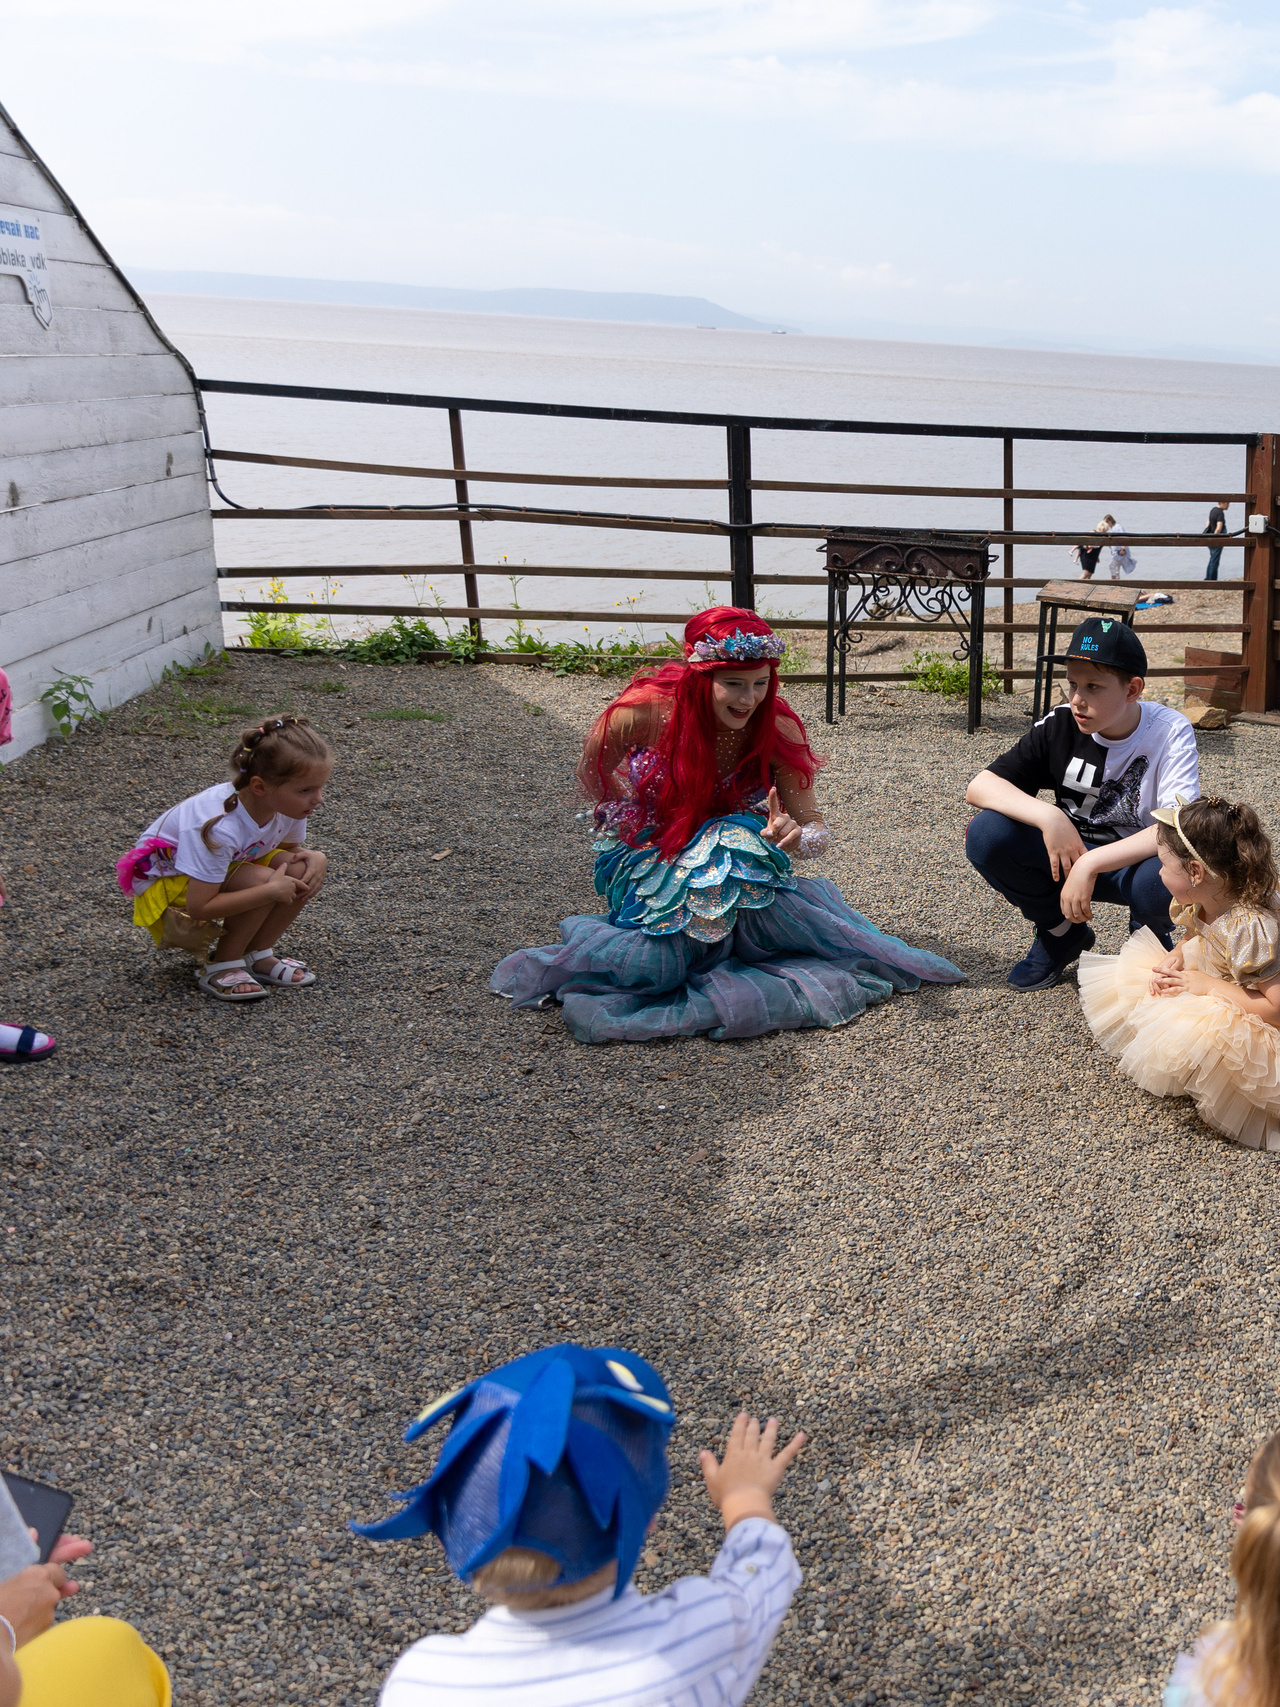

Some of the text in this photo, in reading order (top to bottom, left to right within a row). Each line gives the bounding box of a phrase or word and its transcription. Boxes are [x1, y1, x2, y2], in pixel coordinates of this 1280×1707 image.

[0, 219, 40, 240] ечай нас
[1082, 636, 1093, 644] NO
[1080, 643, 1099, 651] RULES
